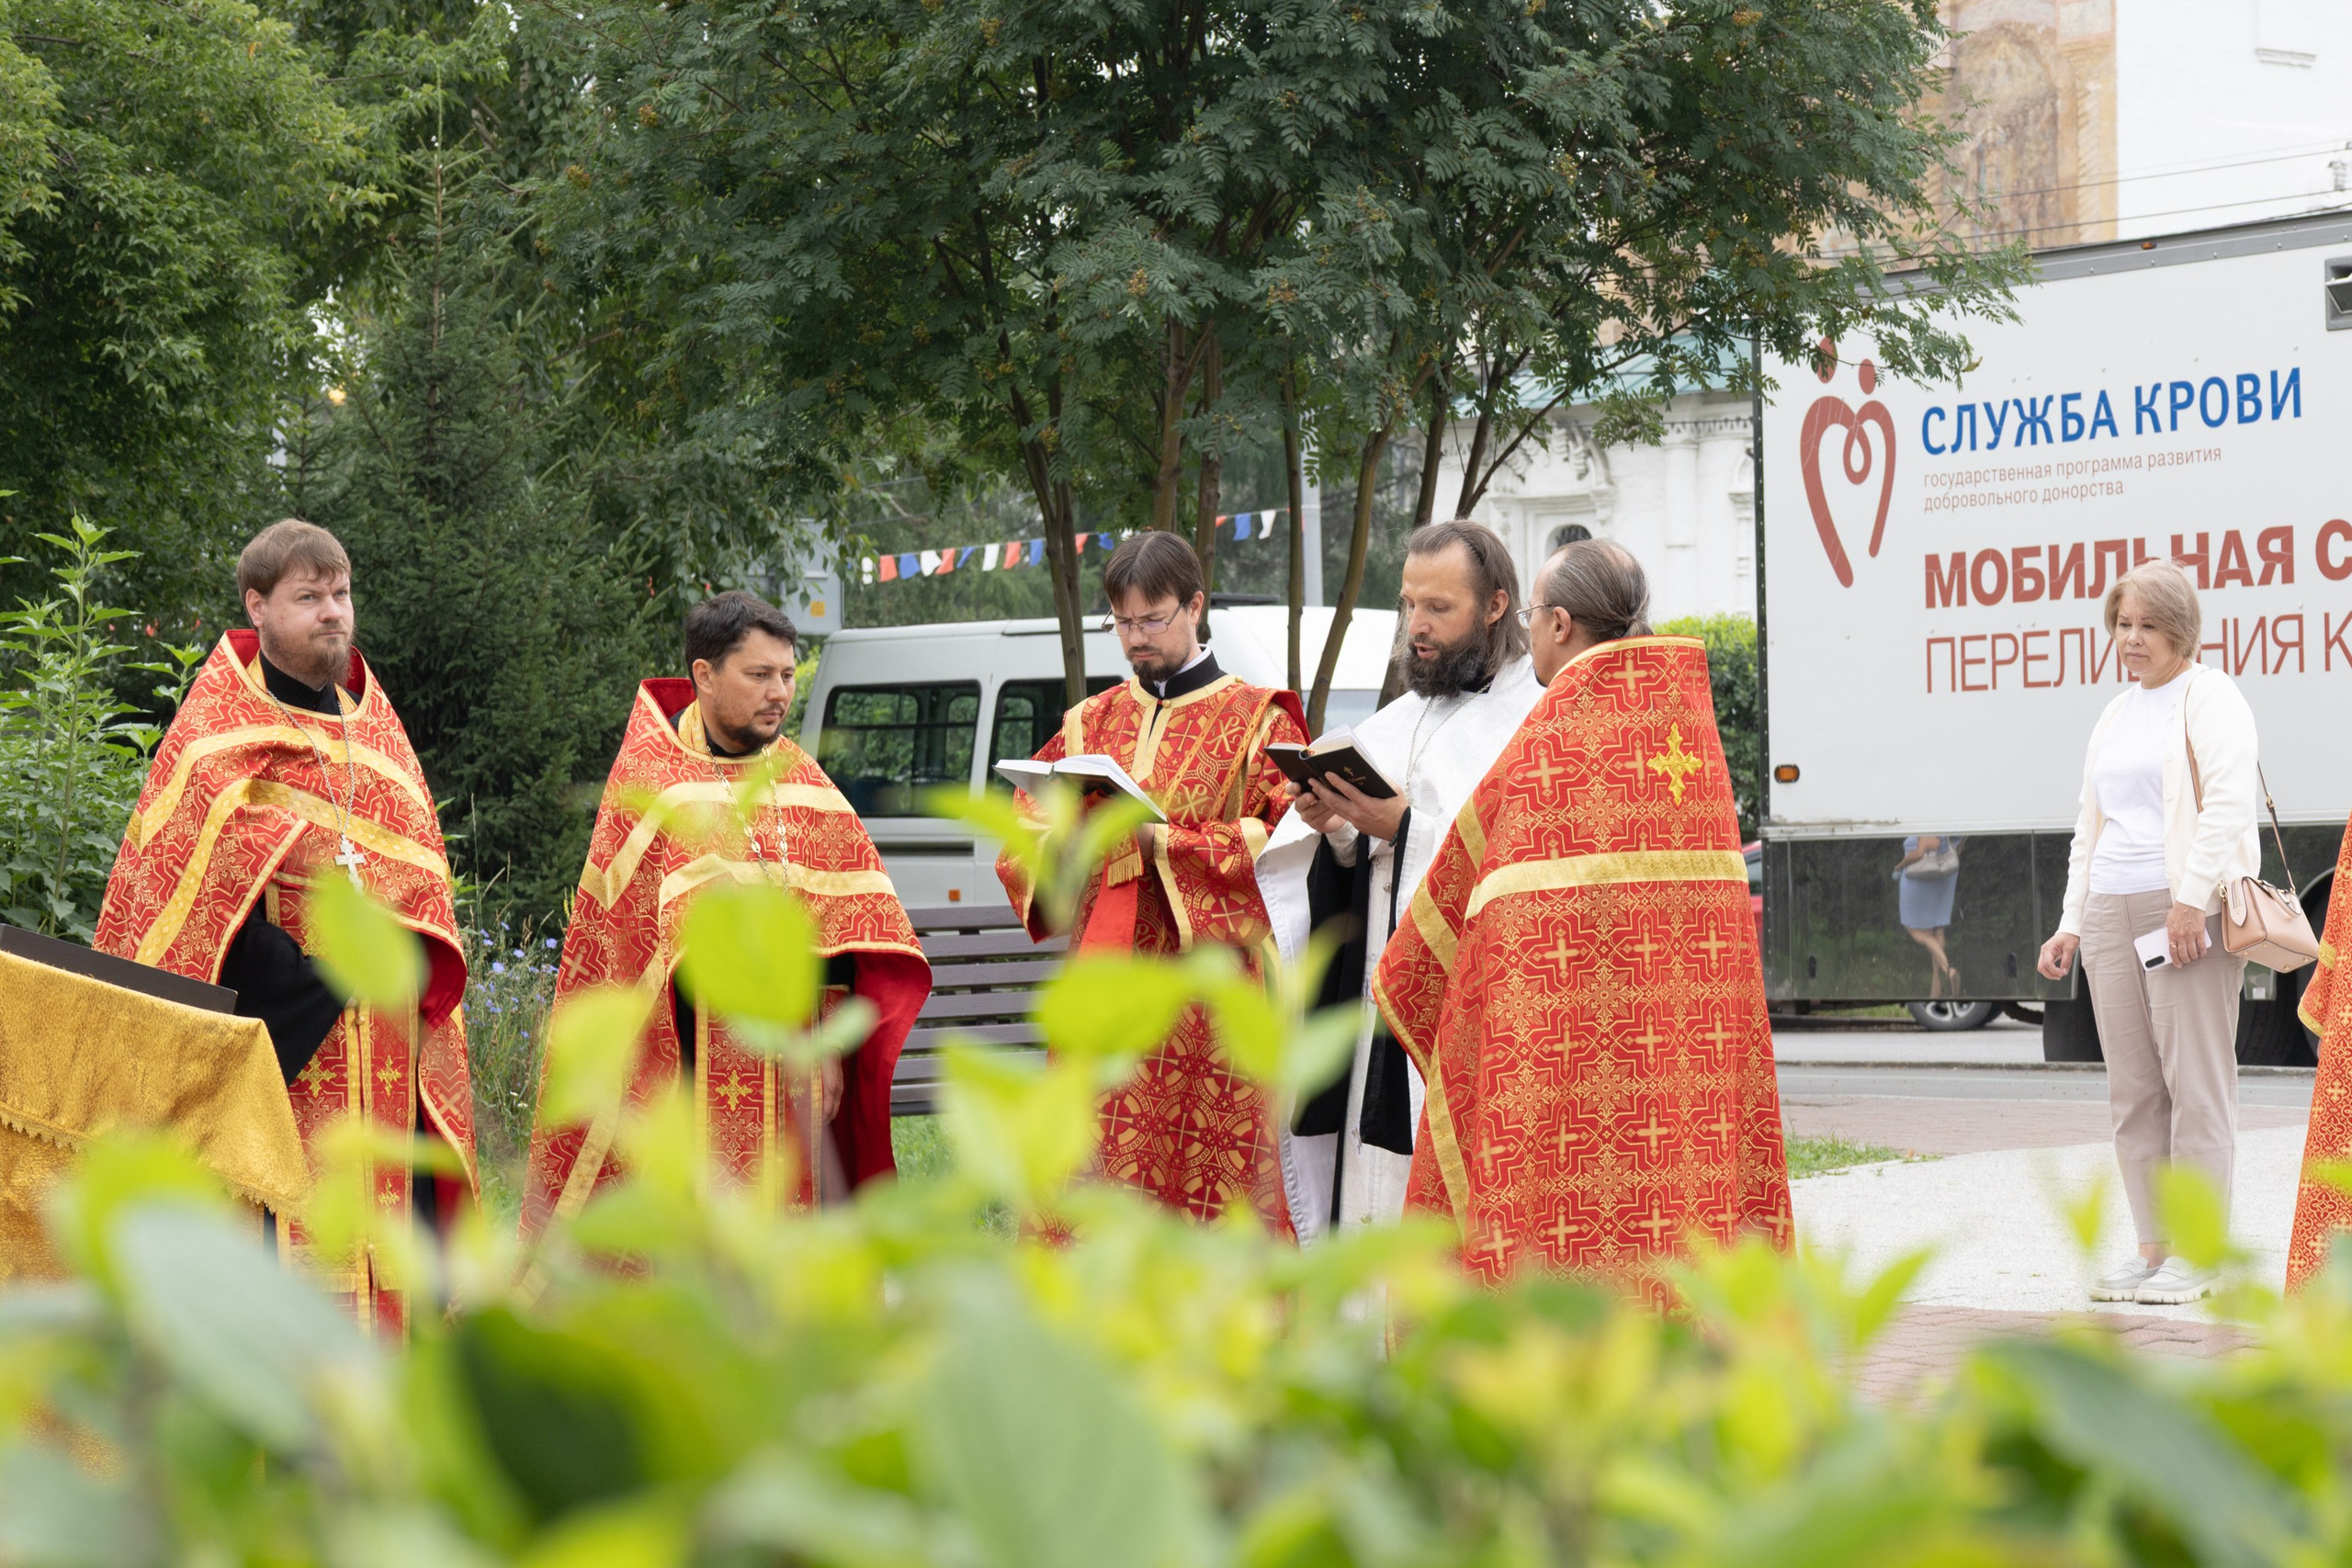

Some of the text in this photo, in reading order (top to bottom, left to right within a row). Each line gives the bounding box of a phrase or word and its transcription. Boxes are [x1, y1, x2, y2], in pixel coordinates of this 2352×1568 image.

[1922, 367, 2302, 456] СЛУЖБА КРОВИ
[1924, 447, 2222, 491] государственная программа развития
[1924, 480, 2124, 513] добровольного донорства
[1927, 614, 2305, 694] ПЕРЕЛИНИЯ
